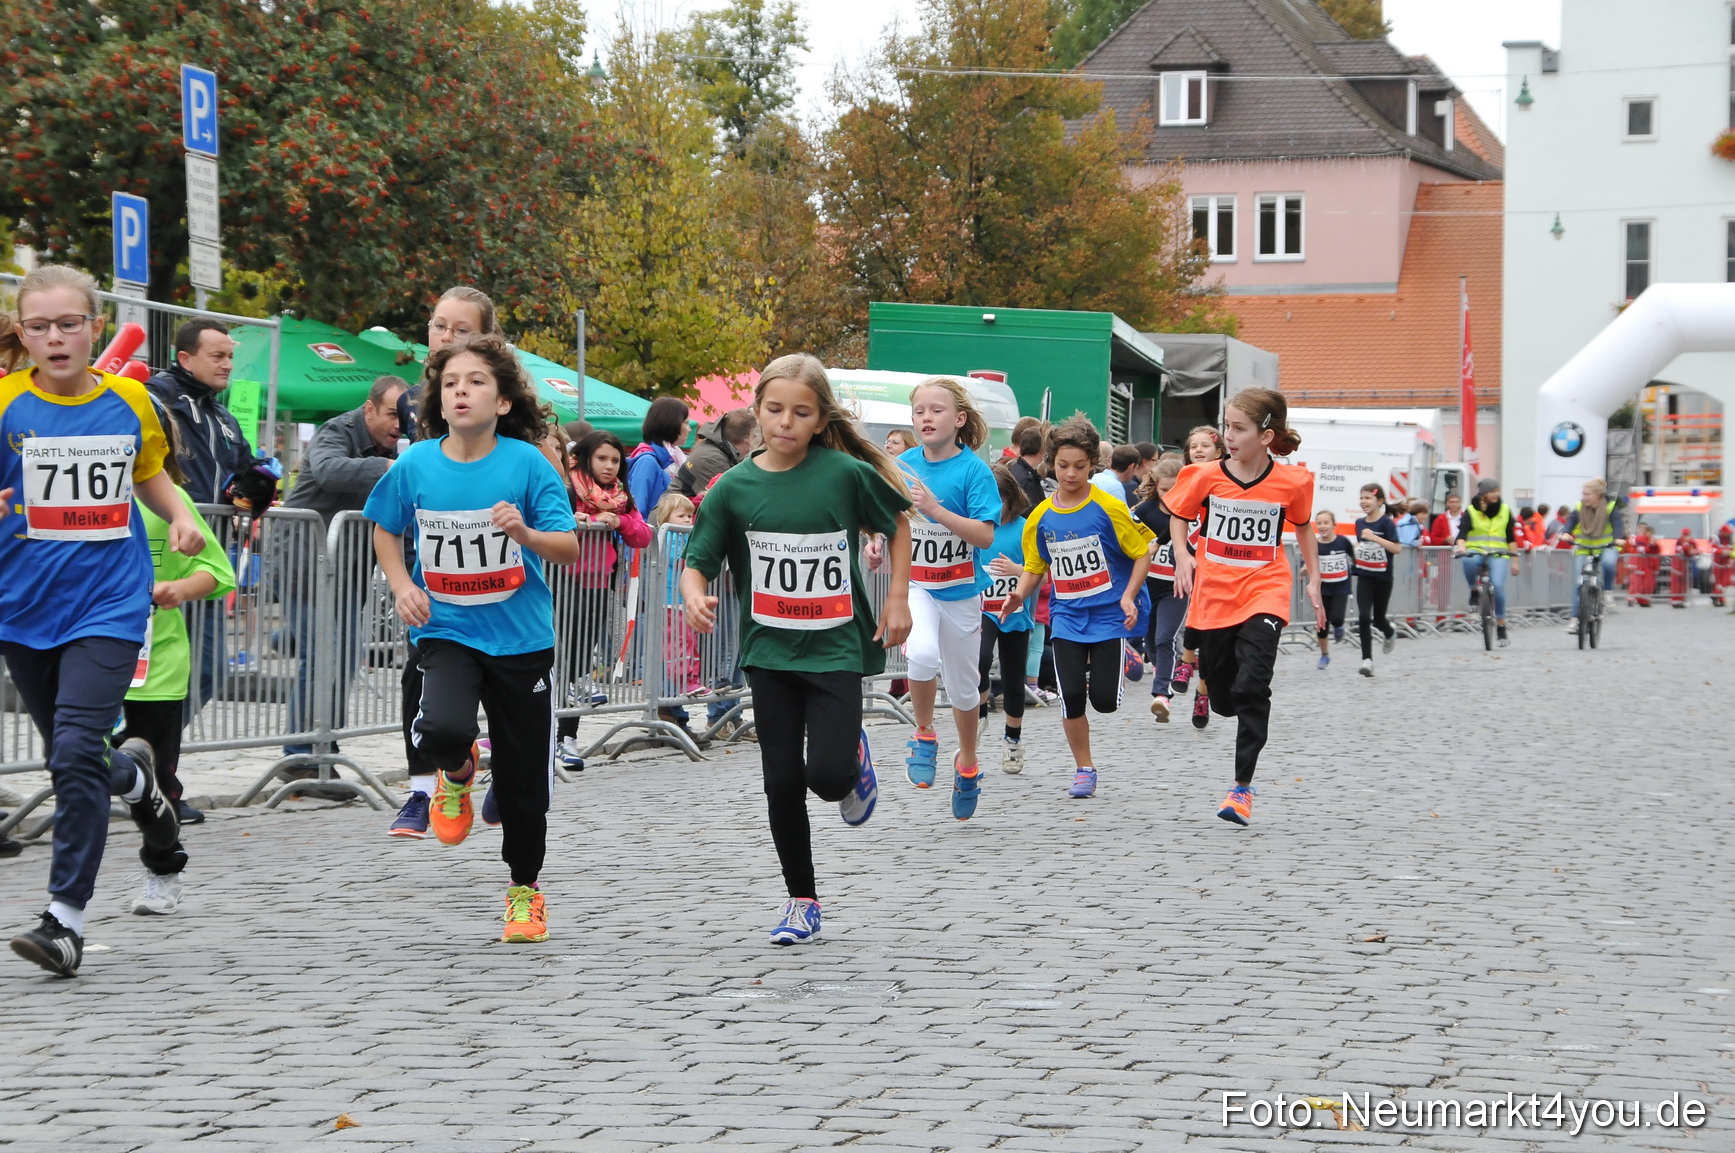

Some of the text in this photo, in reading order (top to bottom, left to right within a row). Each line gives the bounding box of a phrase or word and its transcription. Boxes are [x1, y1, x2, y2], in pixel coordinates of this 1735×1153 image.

[190, 78, 210, 140] P
[121, 206, 141, 270] P
[26, 447, 120, 458] PARTL Neumarkt
[1321, 462, 1374, 472] Bayerisches
[36, 461, 127, 501] 7167
[1321, 473, 1345, 482] Rotes
[1320, 484, 1345, 492] Kreuz
[1211, 501, 1268, 515] PARTL Neumarkt
[63, 511, 107, 526] Meike
[420, 518, 494, 530] PARTL Neumar
[1215, 513, 1271, 542] 7039
[426, 531, 510, 568] 7117
[750, 539, 833, 553] PARTL Neumarkt
[911, 538, 968, 564] 7044
[1060, 543, 1090, 554] Neumarkt
[1224, 546, 1252, 558] Marie
[1357, 549, 1384, 561] 7543
[1321, 560, 1345, 572] 7545
[758, 556, 842, 592] 7076
[924, 569, 952, 580] Larah
[442, 576, 506, 592] Franziska
[984, 577, 1018, 598] 028
[1067, 580, 1091, 591] Stella
[777, 600, 823, 619] Svenja
